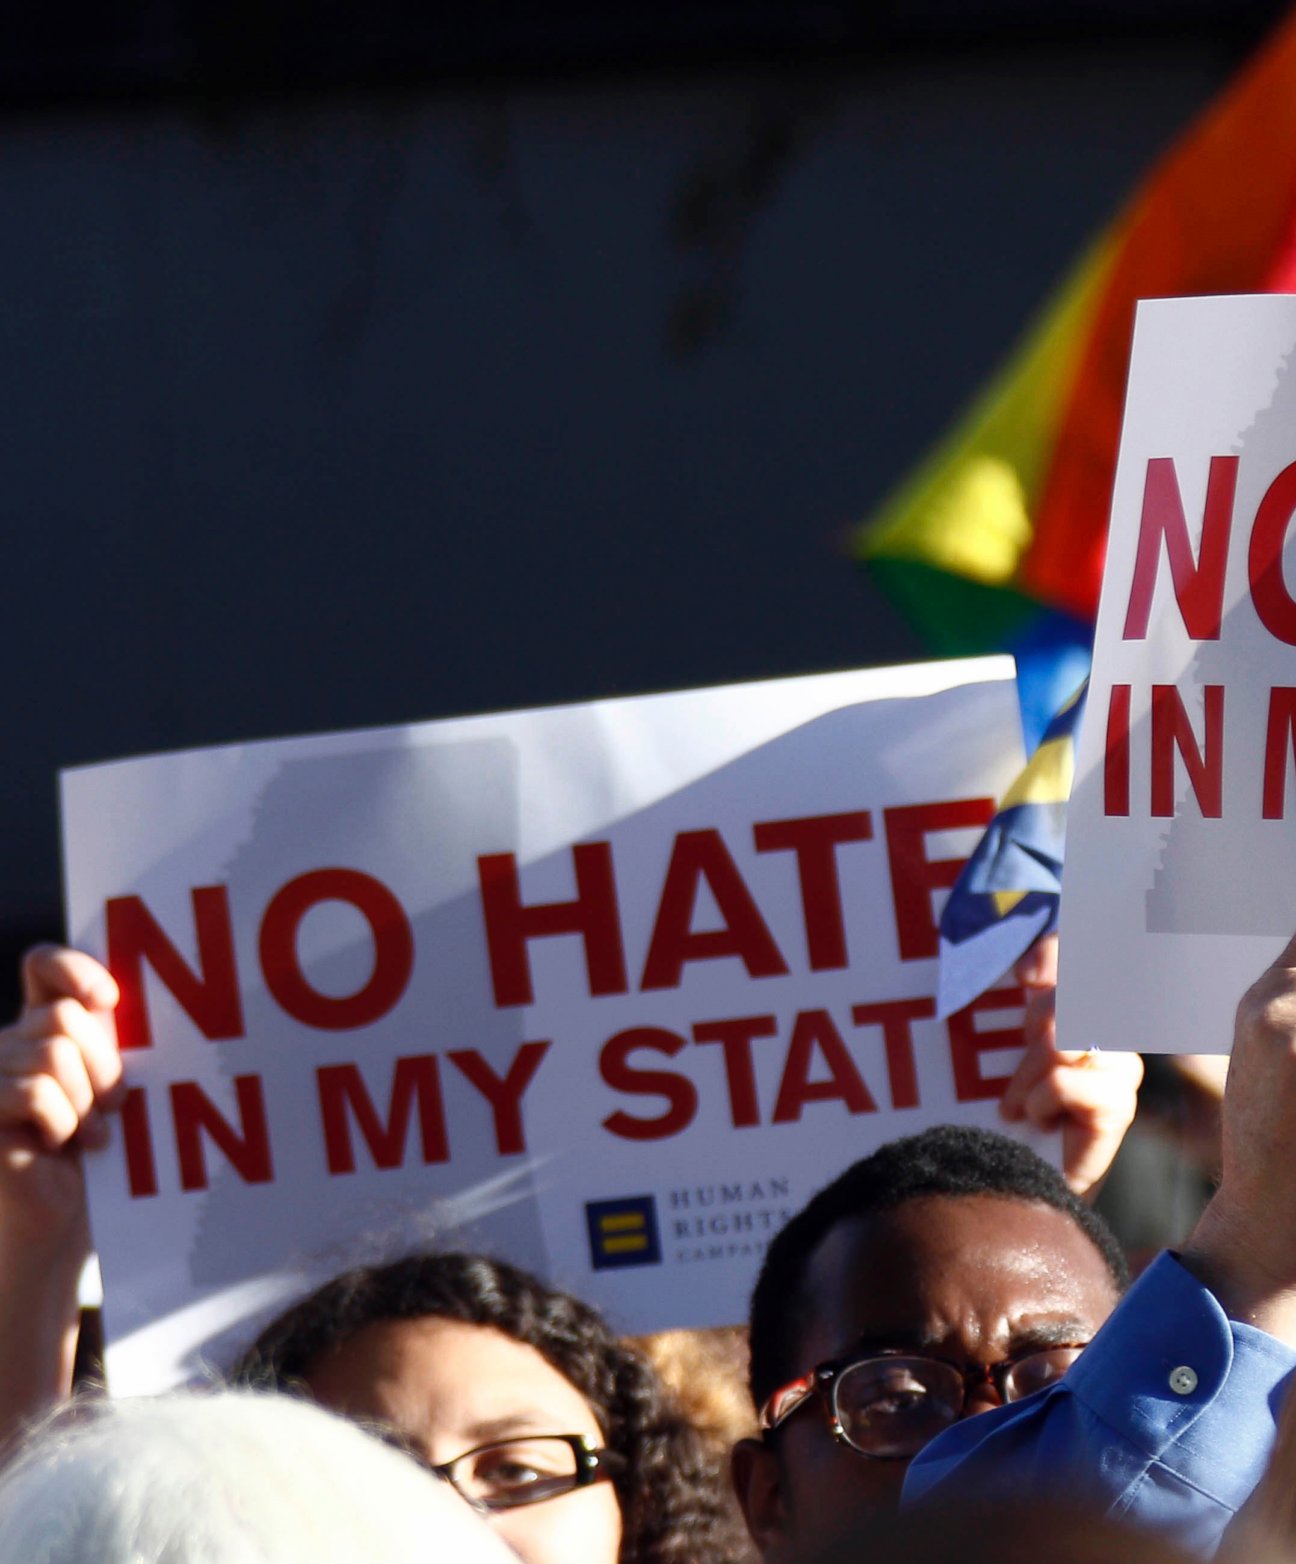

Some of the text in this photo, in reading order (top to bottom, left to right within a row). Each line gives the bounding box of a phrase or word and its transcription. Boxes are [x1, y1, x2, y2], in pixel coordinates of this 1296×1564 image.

[1103, 683, 1225, 819] IN
[104, 796, 998, 1051] NO HATE
[116, 987, 1028, 1200] IN MY STATE
[670, 1177, 789, 1208] HUMAN
